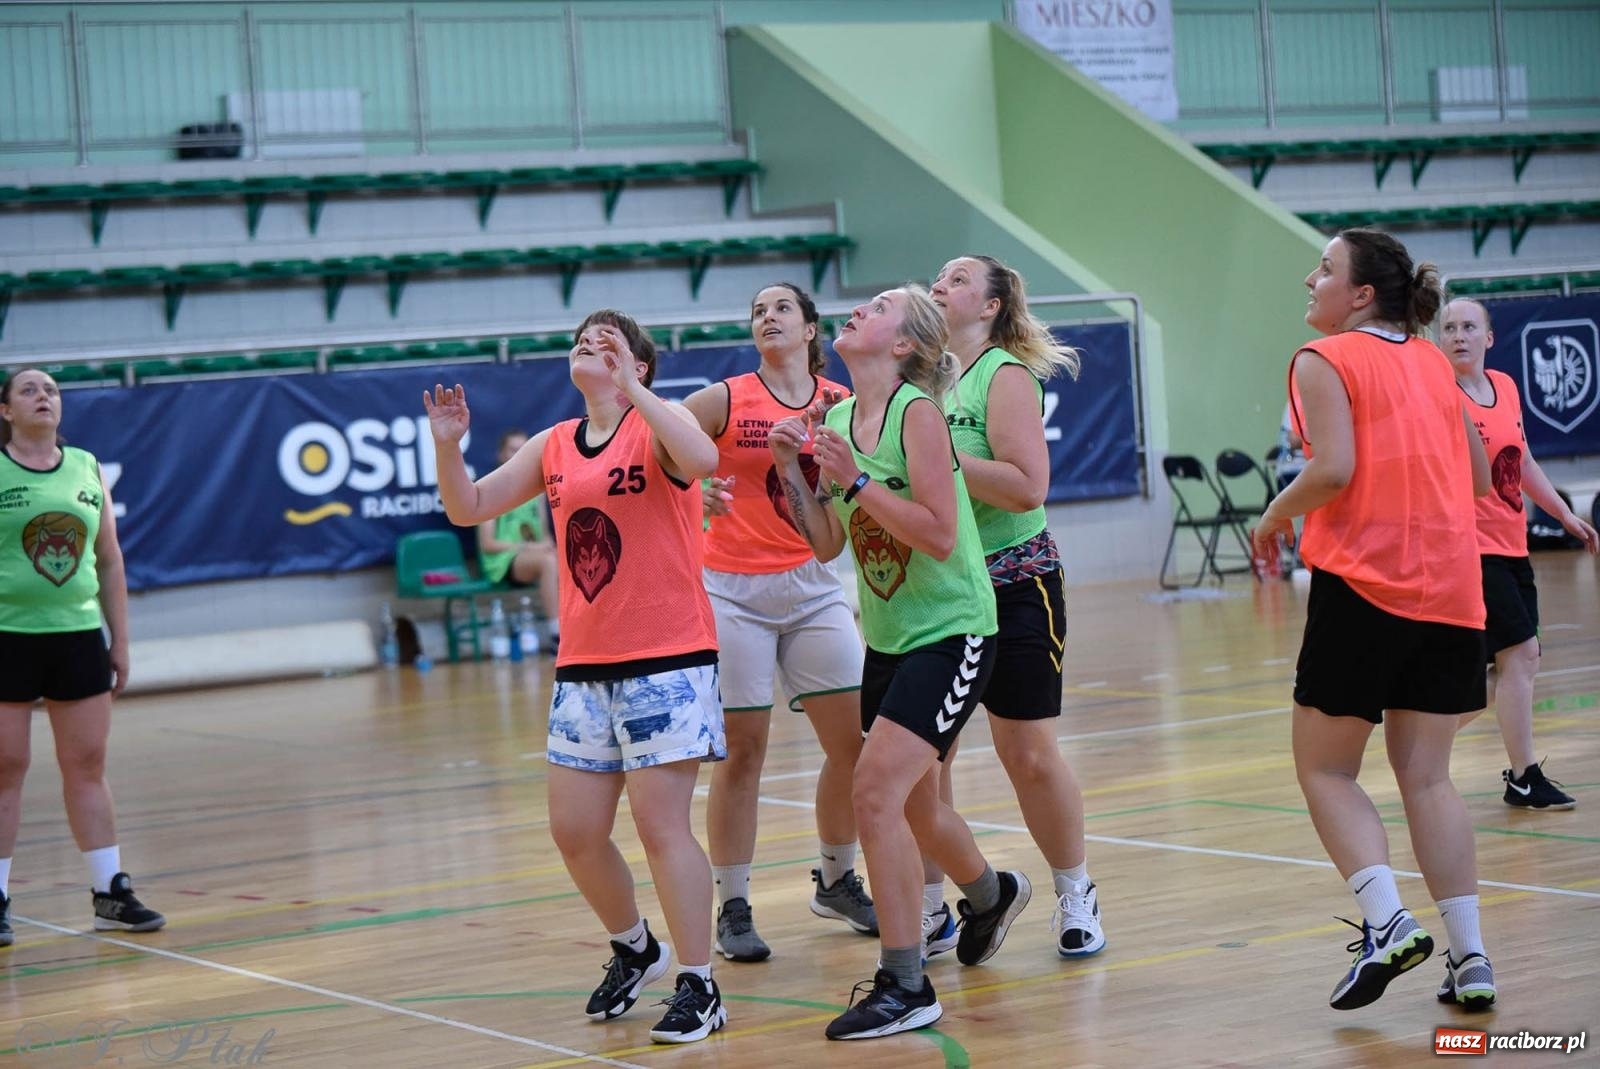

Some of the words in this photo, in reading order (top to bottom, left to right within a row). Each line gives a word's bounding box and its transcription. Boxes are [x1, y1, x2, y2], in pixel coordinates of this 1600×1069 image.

[1035, 0, 1157, 28] MIESZKO
[737, 420, 775, 429] LETNIA
[743, 429, 769, 438] LIGA
[736, 439, 769, 449] KOBIE
[607, 465, 647, 497] 25
